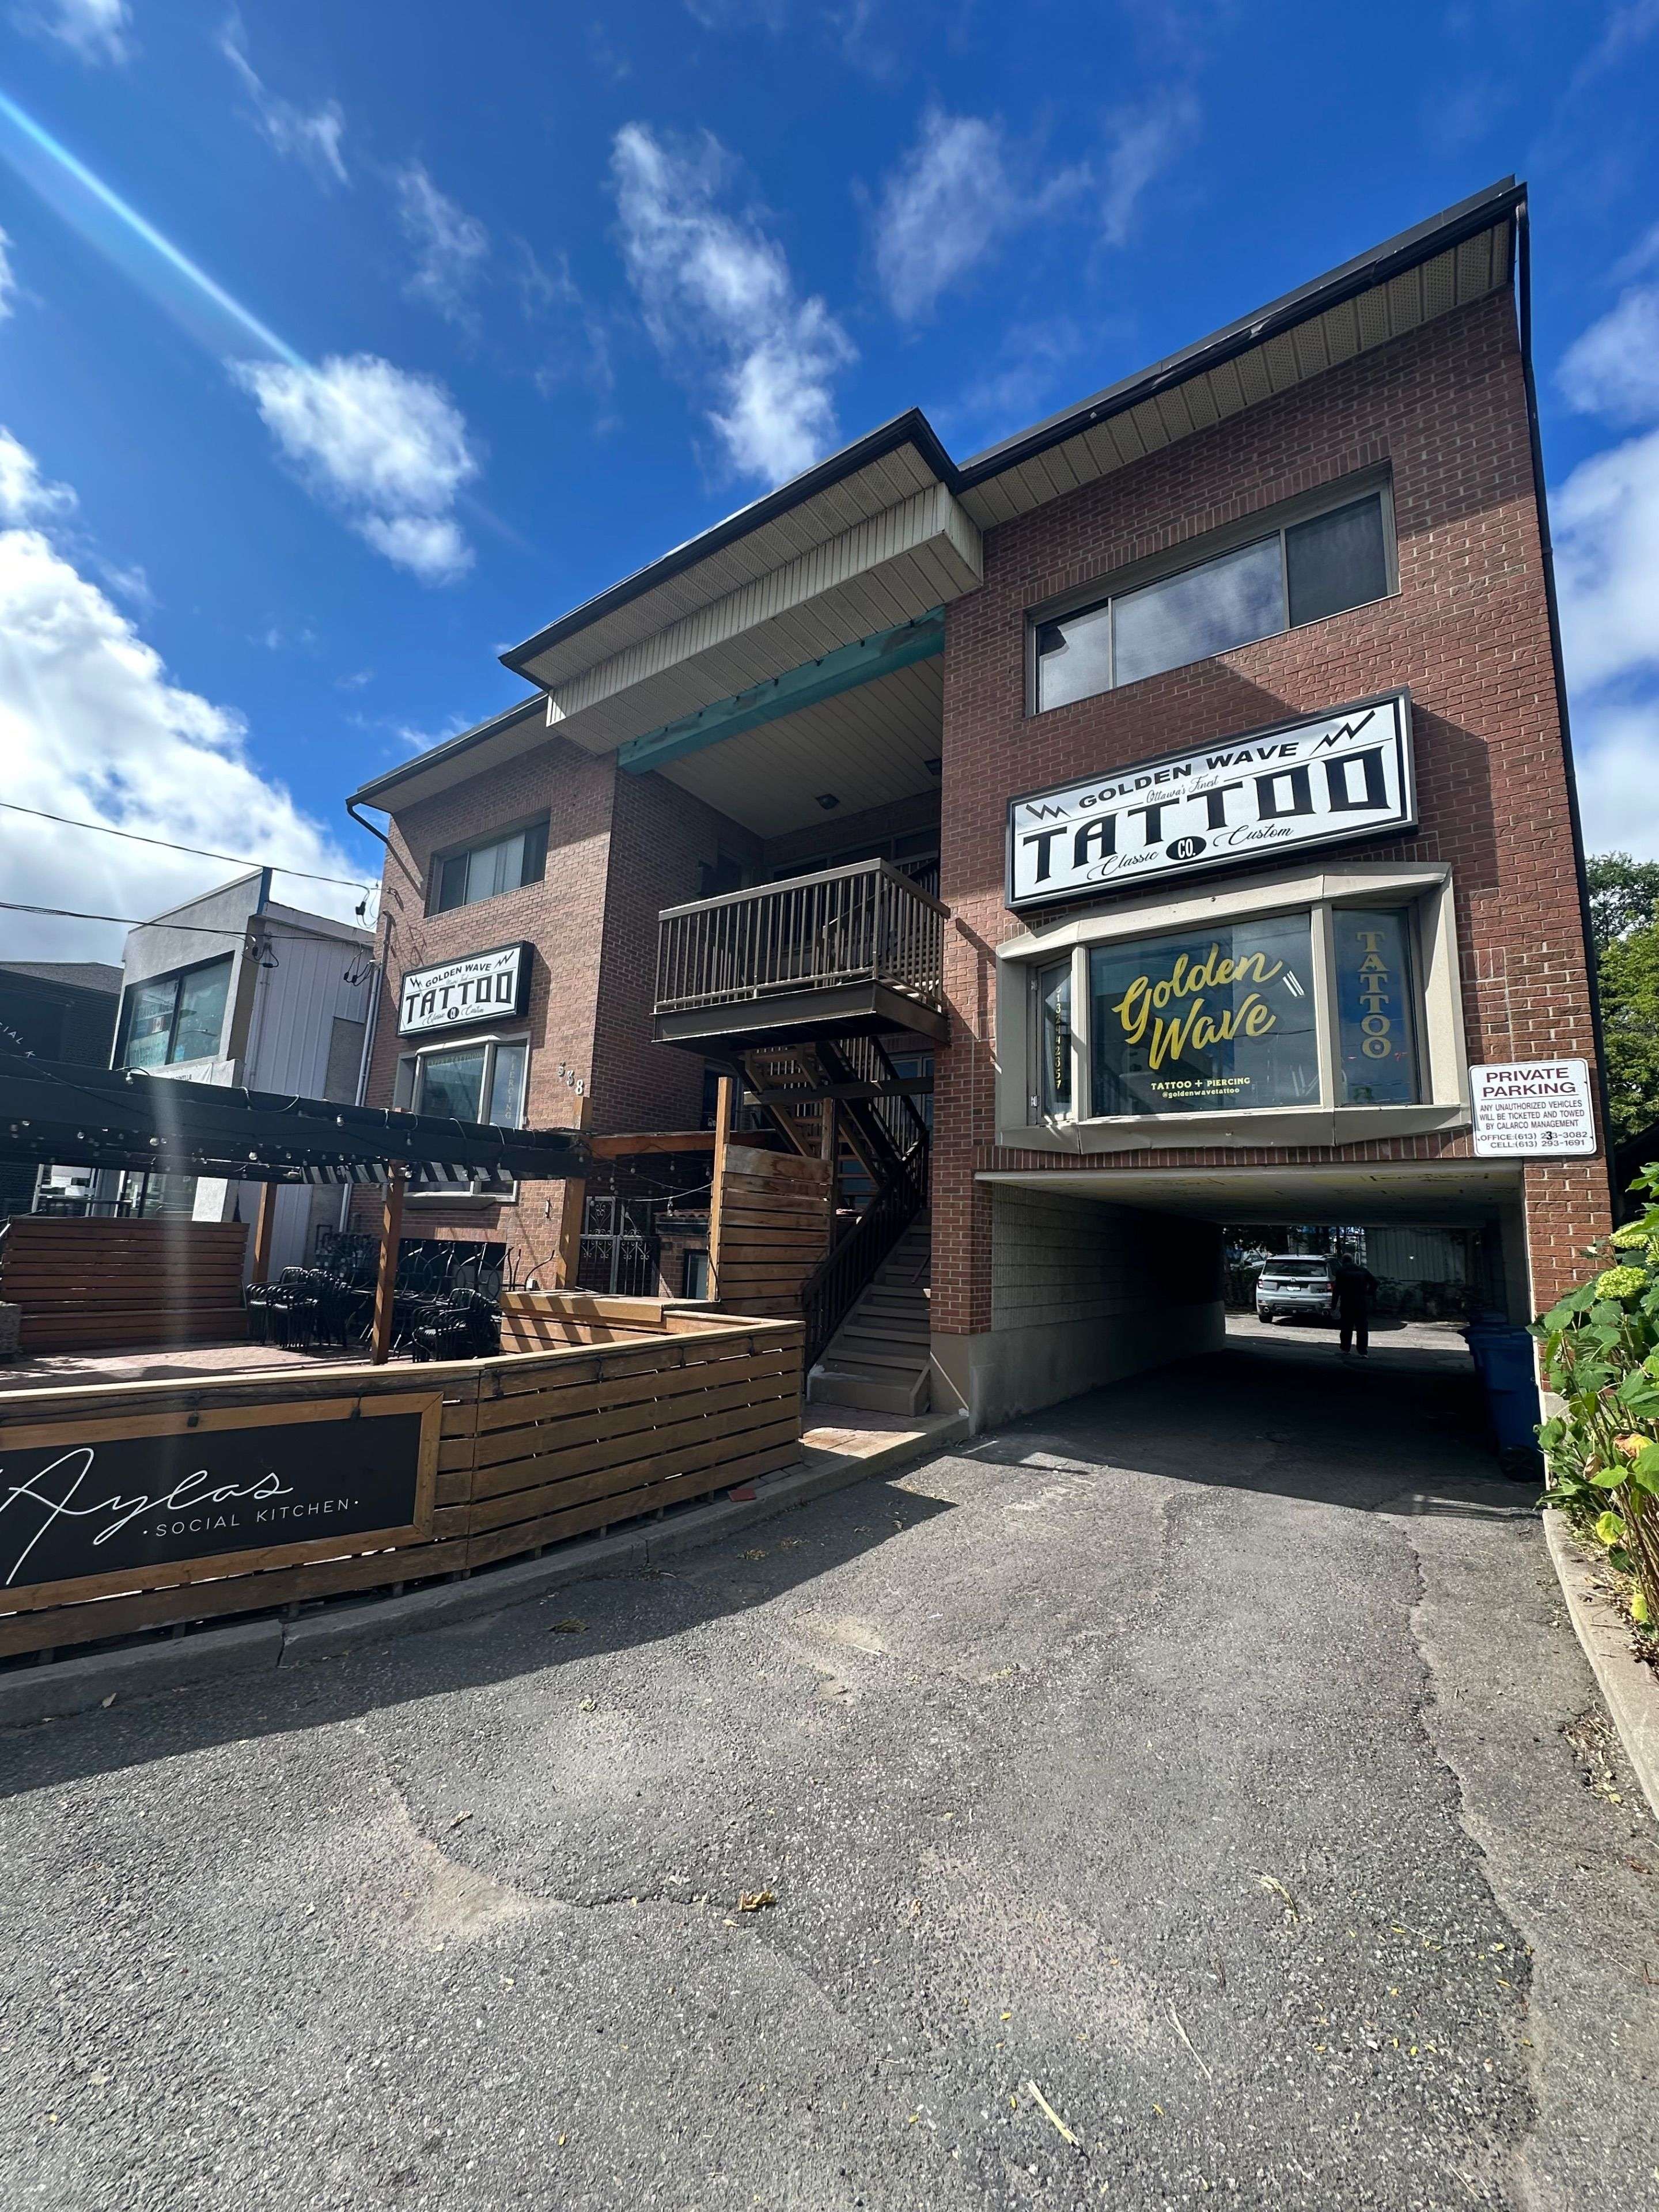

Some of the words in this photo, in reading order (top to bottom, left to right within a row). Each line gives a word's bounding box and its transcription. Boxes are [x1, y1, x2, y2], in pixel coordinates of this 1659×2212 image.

[1079, 764, 1192, 809] GOLDEN
[1206, 742, 1299, 770] WAVE
[1146, 785, 1186, 804] Ottawa's
[1188, 774, 1220, 793] Finest
[1022, 746, 1392, 884] TATTOO
[1087, 851, 1159, 880] Classic
[1213, 824, 1294, 847] Custom
[425, 967, 463, 987] GOLDEN
[465, 963, 492, 972] WAVE
[406, 970, 514, 1024] TATTOO
[1112, 943, 1282, 1044] Golden
[1357, 931, 1392, 1059] TATTOO
[1149, 993, 1277, 1070] Wave
[505, 1055, 517, 1119] PIERCING
[1151, 1081, 1192, 1090] TATTOO
[1207, 1077, 1251, 1087] PIERCING
[1483, 1082, 1576, 1097] PARKING
[1486, 1067, 1569, 1083] PRIVATE
[1162, 1088, 1240, 1099] @goldenwavetattoo
[1495, 1101, 1546, 1111] UNAUTHORIZED
[1548, 1100, 1582, 1108] VEHICLES
[1497, 1121, 1528, 1130] CALARCO
[1531, 1119, 1579, 1128] MANAGEMENT
[1509, 1111, 1540, 1120] TICKETED
[1559, 1109, 1585, 1118] TOWED
[1541, 1139, 1585, 1147] 293-1691
[156, 1514, 240, 1537] SOCIAL
[256, 1500, 350, 1522] KITCHEN
